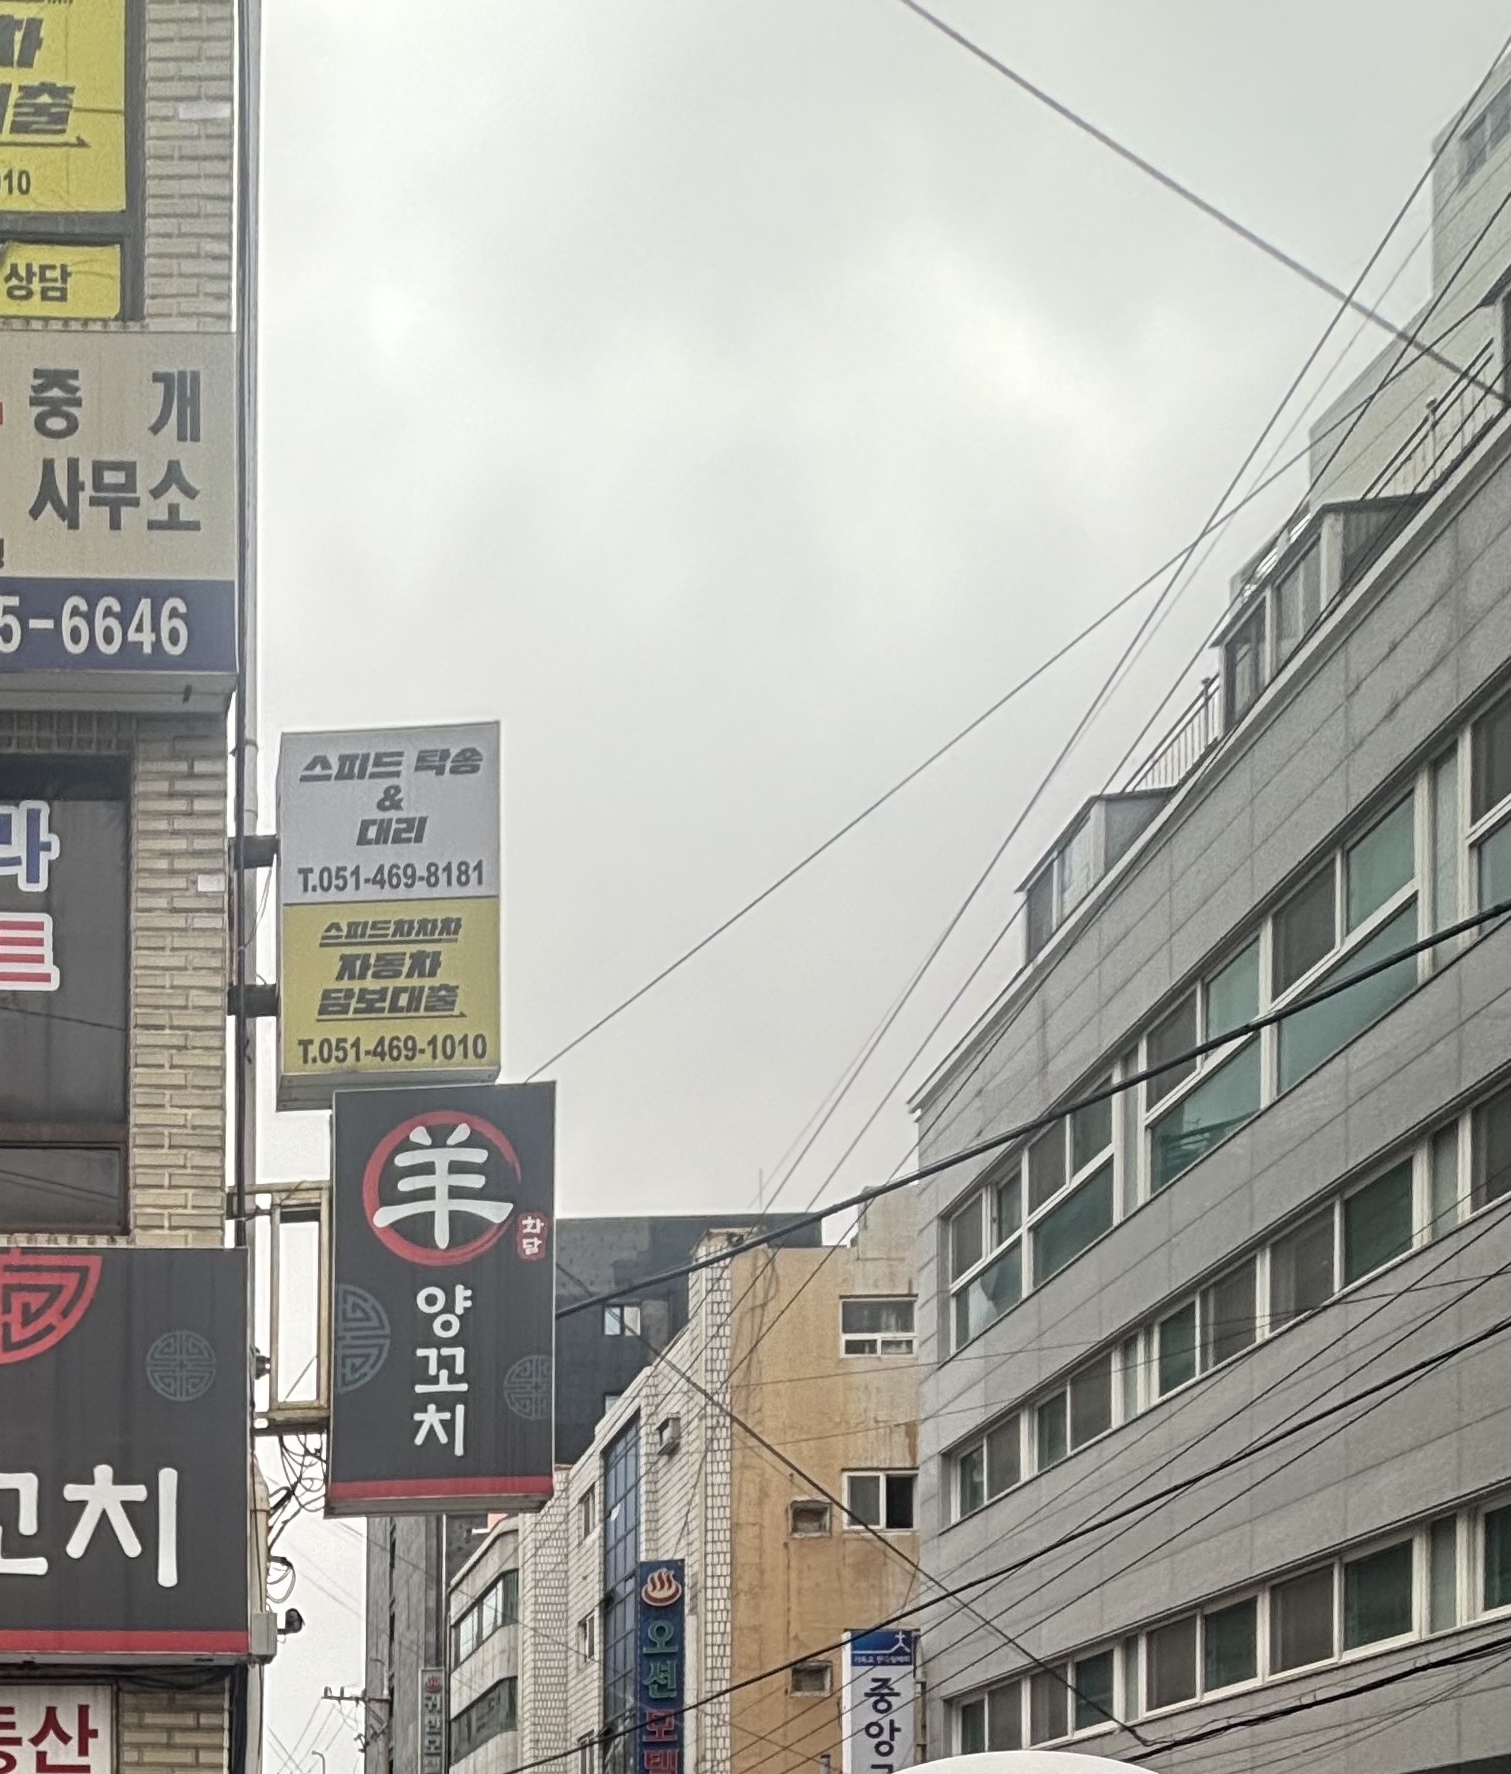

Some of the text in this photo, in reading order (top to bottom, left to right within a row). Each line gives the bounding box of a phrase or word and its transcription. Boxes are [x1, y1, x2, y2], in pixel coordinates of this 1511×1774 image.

[4, 261, 72, 305] 상담
[28, 456, 201, 534] 사무소
[299, 750, 406, 784] 스피드
[376, 784, 405, 812] &
[356, 815, 430, 847] 대리
[297, 859, 485, 894] T.051-469-8181
[335, 950, 443, 983] 자동차
[317, 982, 460, 1018] 담보대출
[297, 1032, 488, 1066] T.051-469-1010
[372, 1122, 515, 1250] 羊
[413, 1283, 474, 1458] 양꼬치
